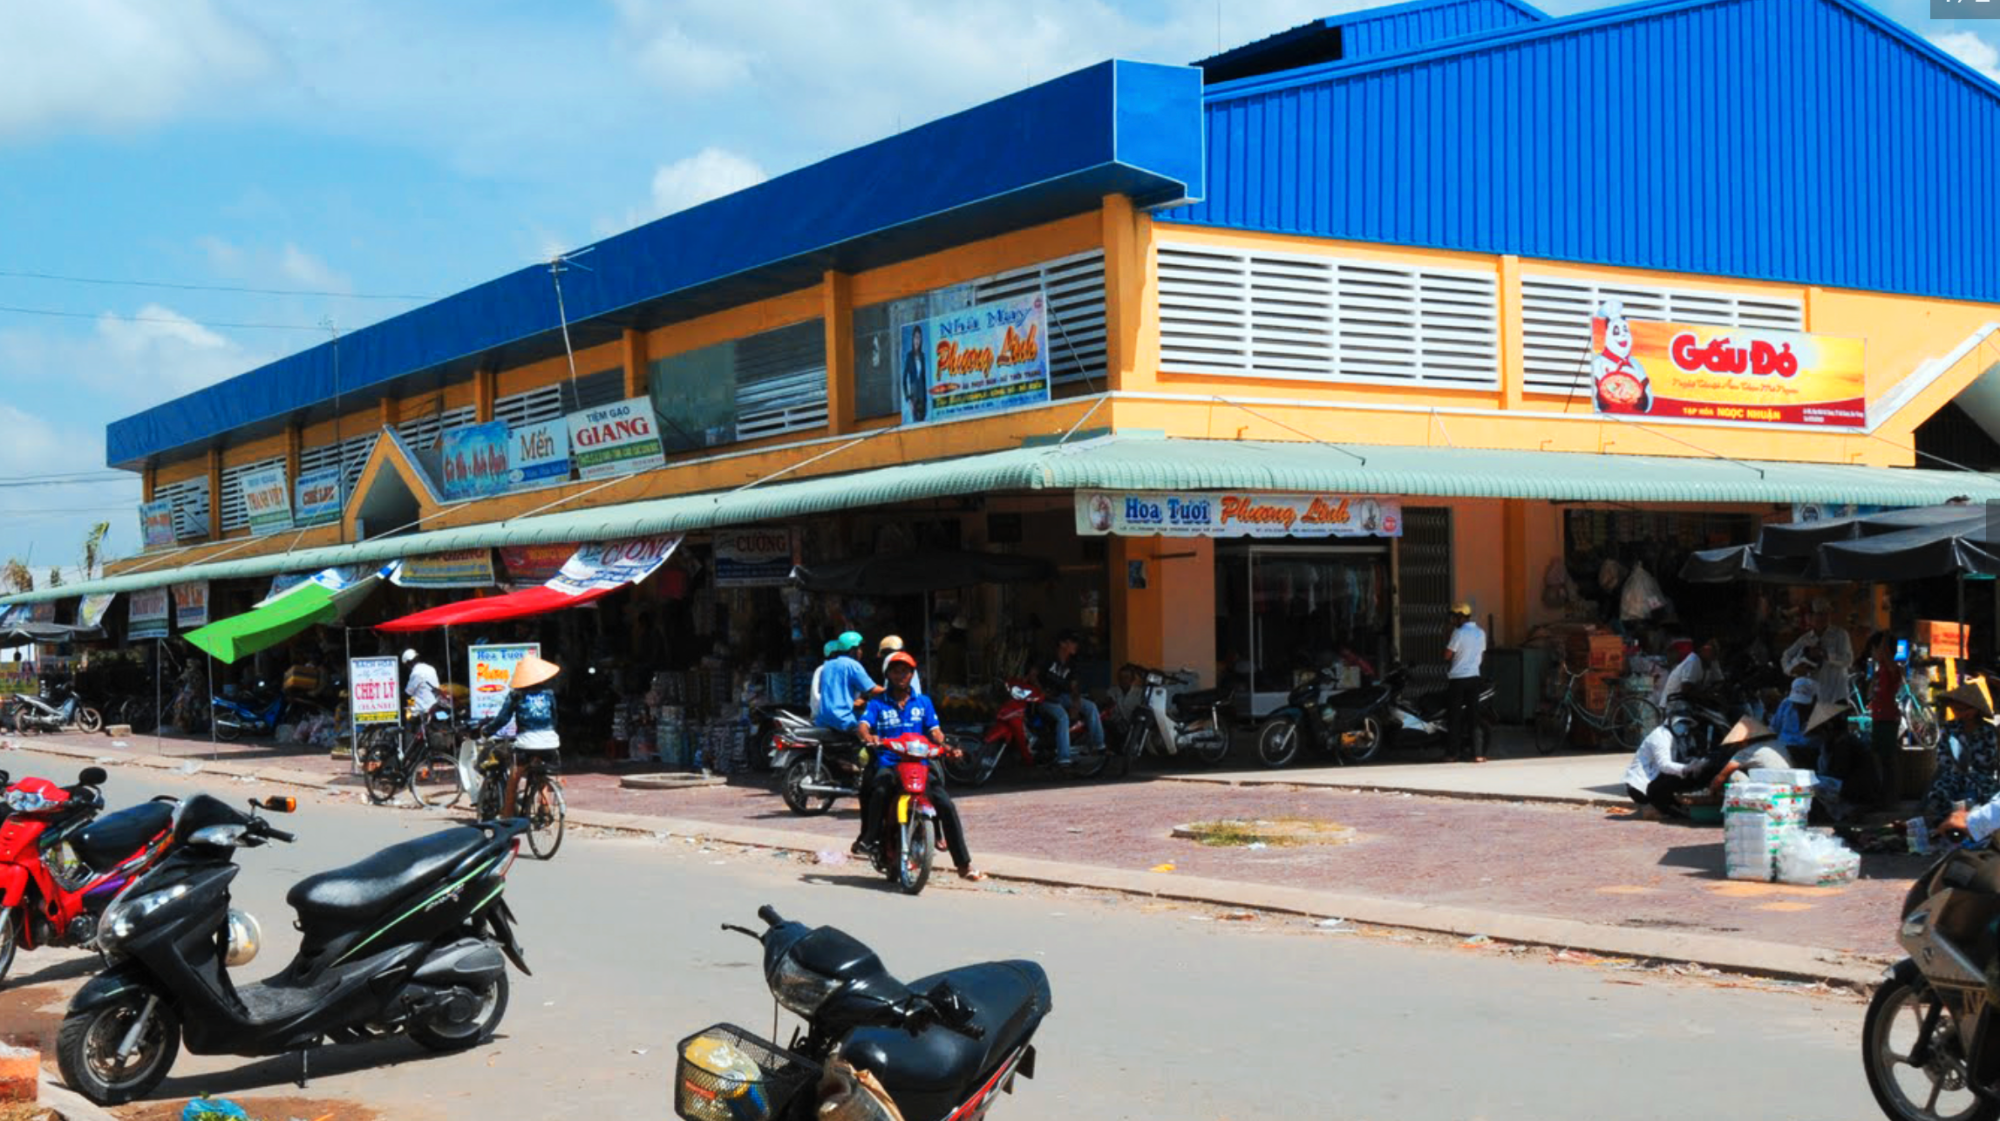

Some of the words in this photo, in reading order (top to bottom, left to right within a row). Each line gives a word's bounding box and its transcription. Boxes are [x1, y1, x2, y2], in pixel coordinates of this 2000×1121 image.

[1671, 334, 1748, 374] Gấu
[1750, 340, 1798, 378] Đỏ
[1717, 407, 1744, 419] NGỌC
[1746, 407, 1781, 421] NHUẬN
[520, 426, 555, 462] Mến
[576, 416, 650, 447] GIANG
[1125, 497, 1162, 523] Hoa
[1167, 497, 1211, 524] Tươi
[736, 531, 786, 552] CƯỜNG
